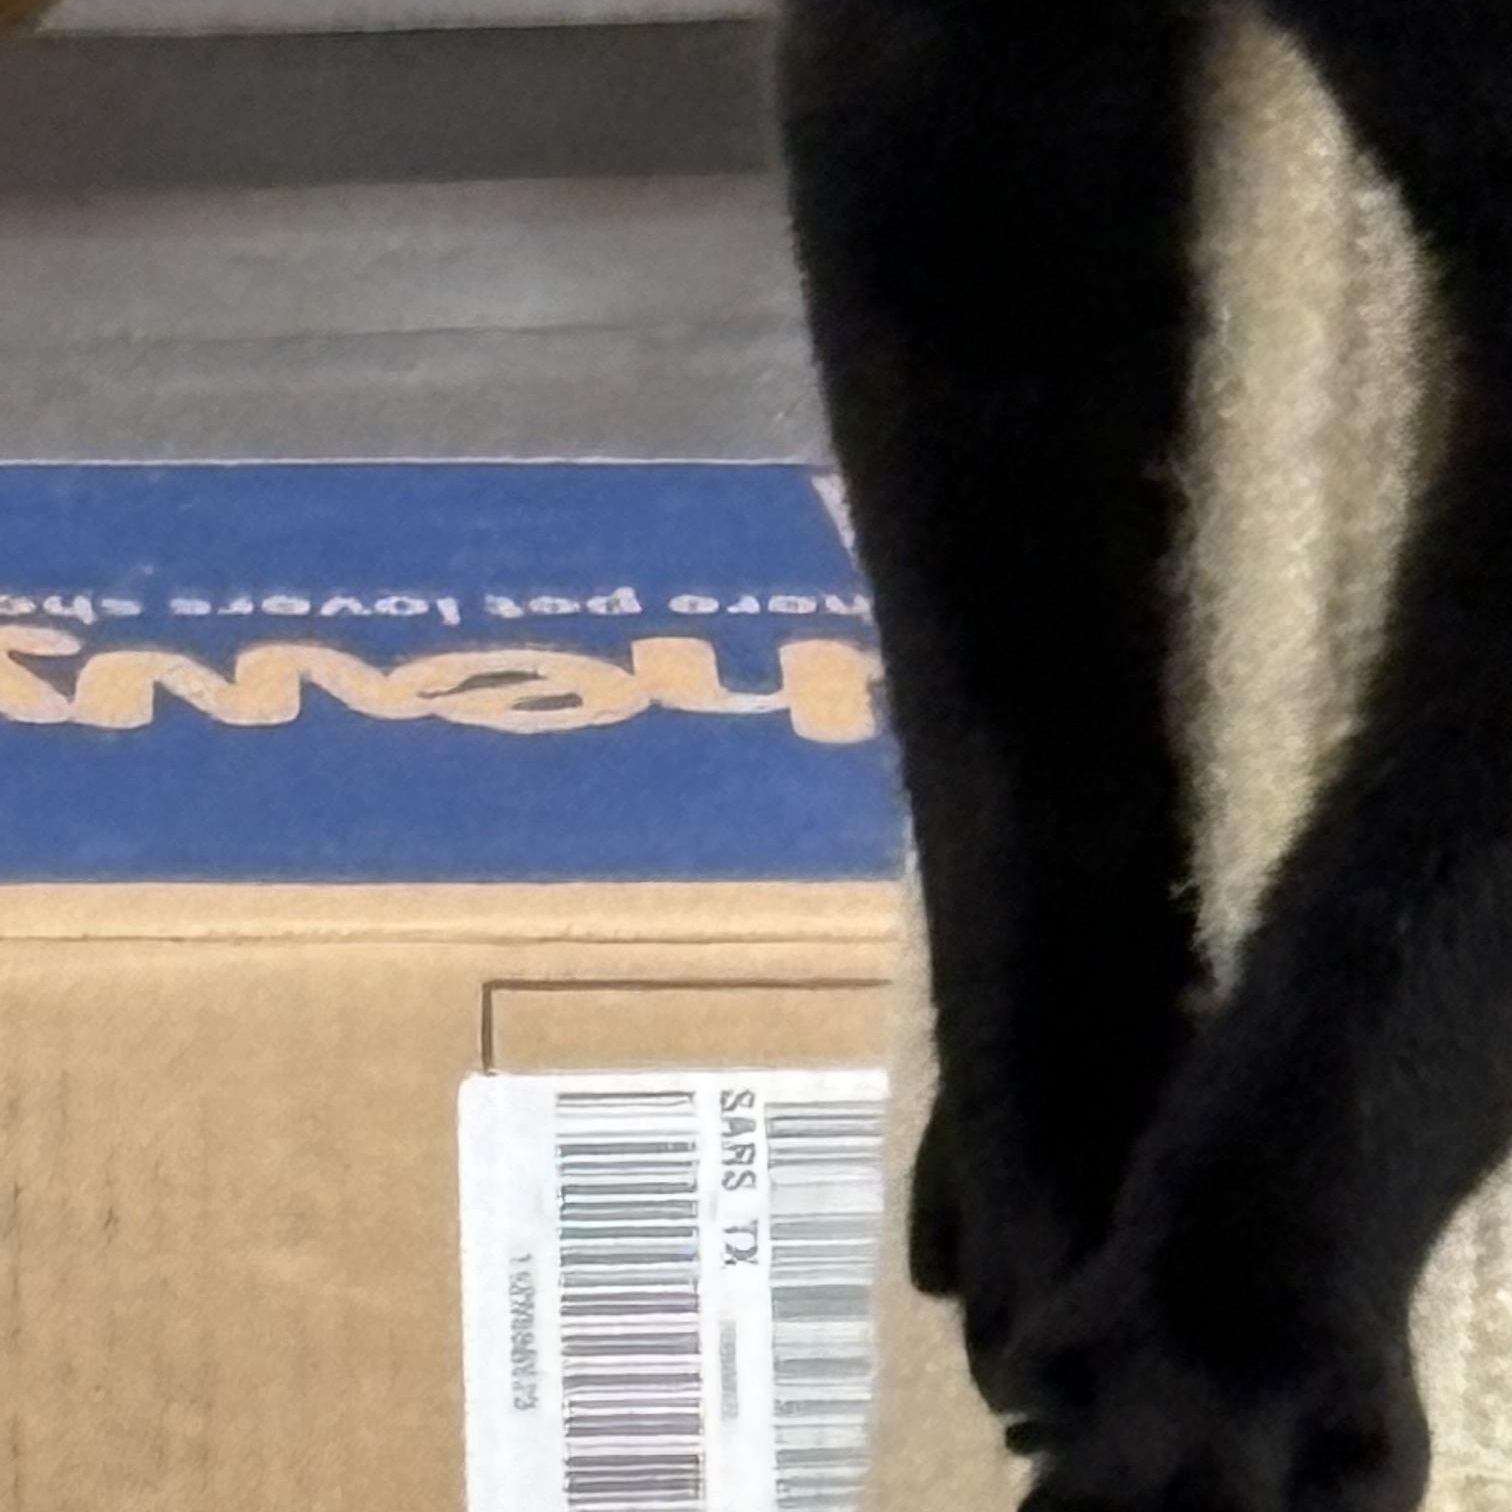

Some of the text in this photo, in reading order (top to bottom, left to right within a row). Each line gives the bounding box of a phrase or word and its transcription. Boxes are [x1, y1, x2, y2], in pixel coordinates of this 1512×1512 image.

[0, 595, 143, 625] sho
[668, 594, 872, 624] here
[0, 624, 884, 744] hewy
